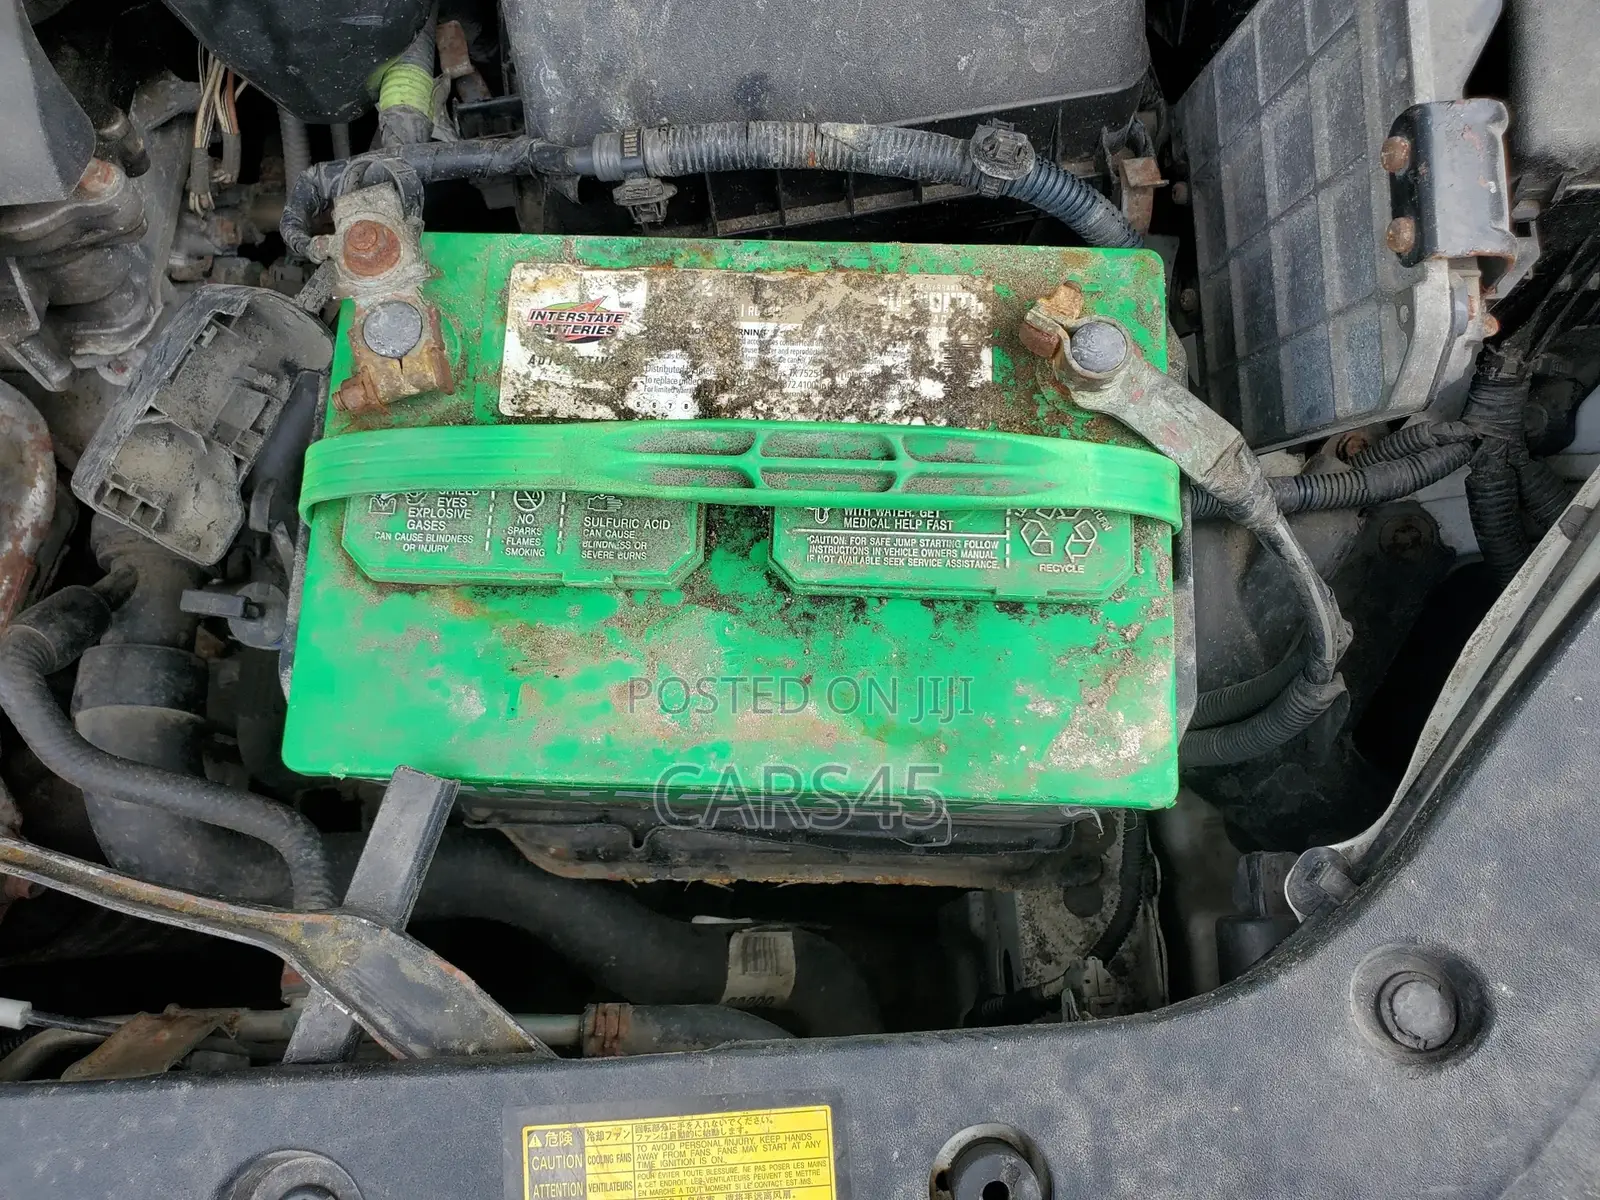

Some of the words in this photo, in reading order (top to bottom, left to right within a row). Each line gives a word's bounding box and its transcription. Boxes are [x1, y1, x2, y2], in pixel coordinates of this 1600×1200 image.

[530, 310, 625, 323] INTERSTATE
[437, 497, 468, 508] EYES
[408, 507, 473, 519] EXPLOSIVE
[516, 513, 535, 525] NO
[406, 519, 447, 531] GASES
[583, 516, 640, 529] SULFURIC
[643, 519, 671, 531] ACID
[843, 517, 891, 529] MEDICAL
[894, 518, 923, 530] HELP
[926, 519, 954, 531] FAST
[374, 531, 392, 541] CAN
[394, 532, 424, 542] CAUSE
[425, 533, 474, 543] BLINDNESS
[507, 526, 543, 536] SPARKS
[582, 528, 602, 538] CAN
[604, 529, 636, 539] CAUSE
[402, 543, 417, 552] OR
[418, 543, 450, 553] INJURY
[506, 537, 542, 546] FLAMES
[634, 541, 648, 550] OR
[849, 536, 867, 546] FOR
[869, 537, 891, 547] SAFE
[893, 538, 917, 547] JUMP
[919, 538, 962, 549] STARTING
[963, 540, 999, 550] FOLLOW
[505, 547, 546, 557] SMOKING
[581, 550, 614, 560] SEVERE
[617, 551, 648, 561] BURNS
[809, 545, 869, 556] INSTRUCTIONS
[872, 547, 882, 556] IN
[884, 547, 919, 557] VEHICLE
[920, 548, 958, 558] OWNERS
[806, 554, 815, 563] IF
[817, 554, 836, 564] NOT
[837, 555, 880, 565] AVAILABLE
[883, 557, 905, 566] SEEK
[907, 557, 943, 568] SERVICE
[945, 559, 1001, 570] ASSISTANCE.
[1039, 563, 1086, 574] RECYCLE
[544, 1130, 574, 1148] 危険
[636, 1144, 648, 1153] TO
[651, 1142, 676, 1152] AVOID
[680, 1139, 723, 1149] PERSONAL
[760, 1135, 781, 1144] KEEP
[785, 1132, 813, 1142] HANDS
[636, 1152, 659, 1161] AWAY
[663, 1149, 687, 1159] FROM
[717, 1146, 738, 1155] FANS
[742, 1144, 759, 1153] MAY
[763, 1142, 788, 1152] START
[791, 1141, 802, 1150] AT
[805, 1140, 822, 1149] ANY
[531, 1152, 584, 1171] CAUTION
[587, 1153, 614, 1166] COOLING
[616, 1152, 632, 1164] FANS
[636, 1160, 656, 1169] TIME
[660, 1157, 695, 1168] IGNITION
[700, 1156, 707, 1165] IS
[683, 1168, 704, 1177] TOUTE
[742, 1165, 752, 1173] NE
[754, 1164, 766, 1172] PAS
[769, 1163, 790, 1171] POSER
[793, 1161, 804, 1169] LES
[808, 1159, 827, 1168] MAINS
[706, 1174, 751, 1184] VENTILATEURS
[753, 1171, 781, 1181] PEUVENT
[784, 1171, 793, 1179] SE
[796, 1168, 821, 1177] METTRE
[532, 1180, 584, 1200] ATTENTION
[588, 1180, 633, 1194] VENTILATEURS
[638, 1188, 647, 1197] EN
[686, 1184, 703, 1194] TOUT
[705, 1182, 732, 1192] MOMENT
[754, 1179, 782, 1189] CONTACT
[786, 1178, 798, 1187] EST
